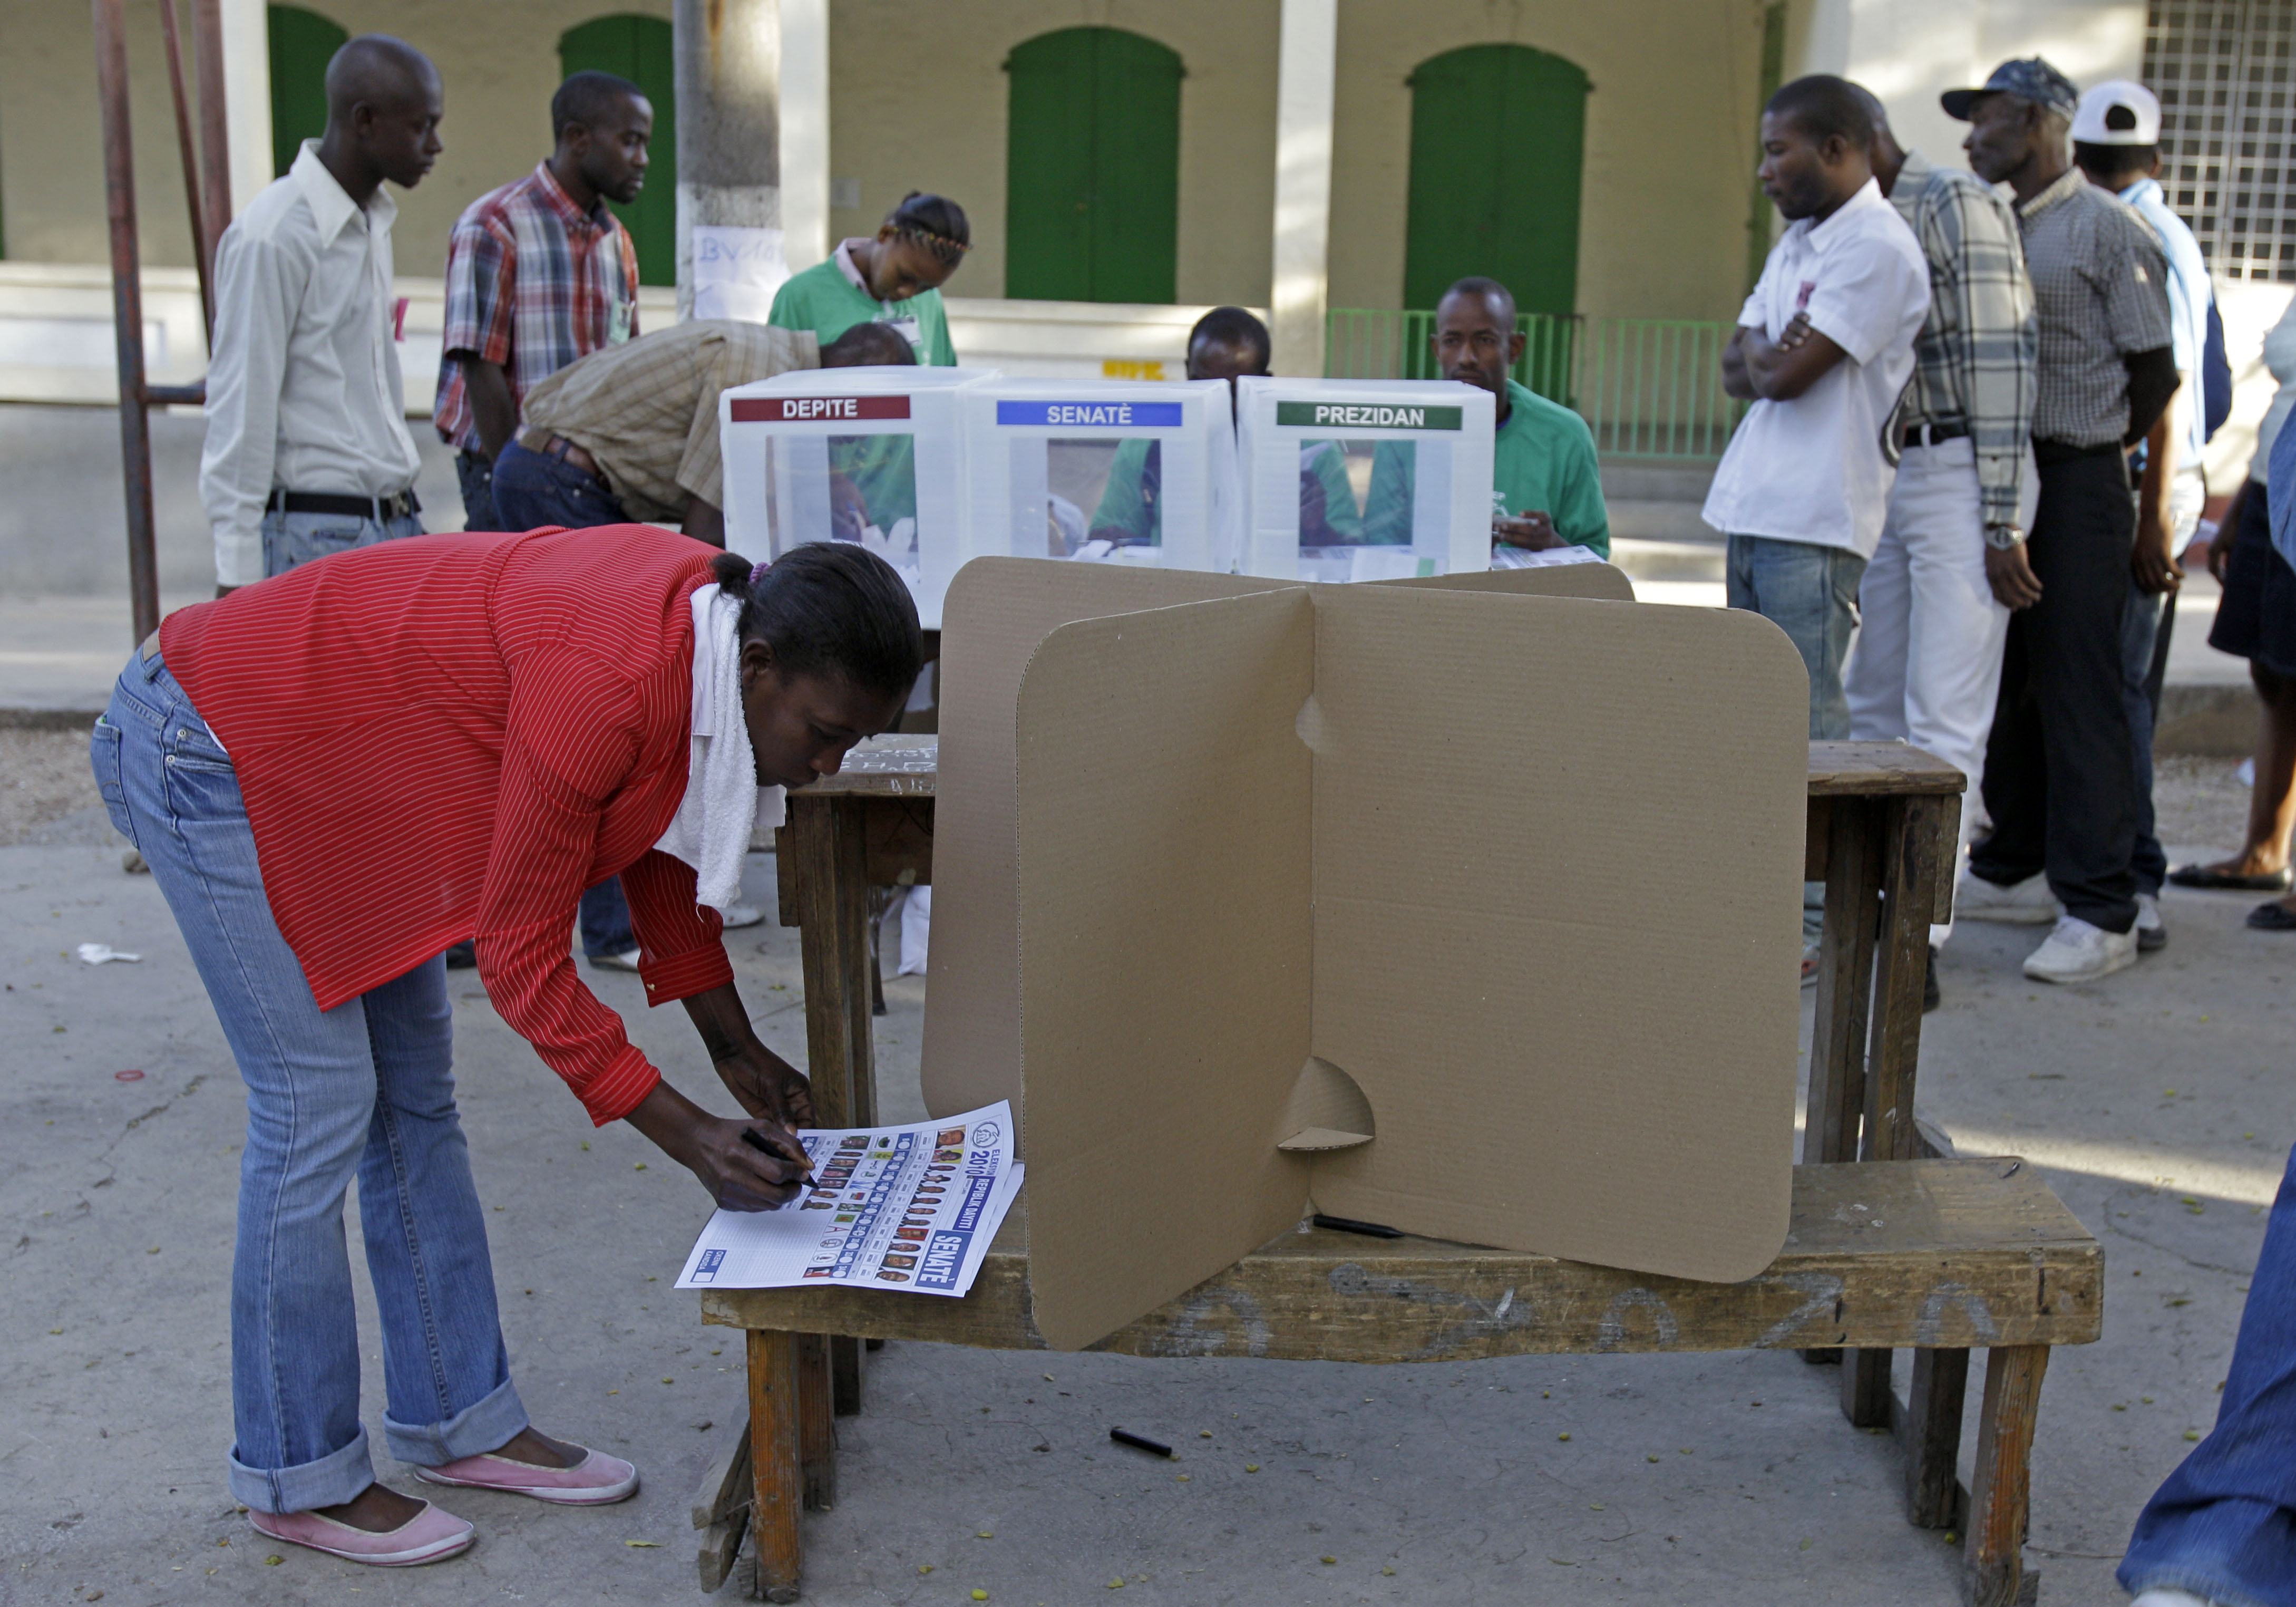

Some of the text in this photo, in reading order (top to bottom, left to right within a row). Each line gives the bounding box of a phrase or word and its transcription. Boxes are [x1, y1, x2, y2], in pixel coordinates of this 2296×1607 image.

[783, 399, 858, 418] DEPITE
[1047, 402, 1132, 424] SENATÈ
[1315, 405, 1424, 425] PREZIDAN
[965, 1151, 989, 1175] 2010
[967, 1178, 990, 1207] REPIBLIK
[958, 1206, 977, 1229] DAYITI
[920, 1235, 962, 1283] SENATÈ
